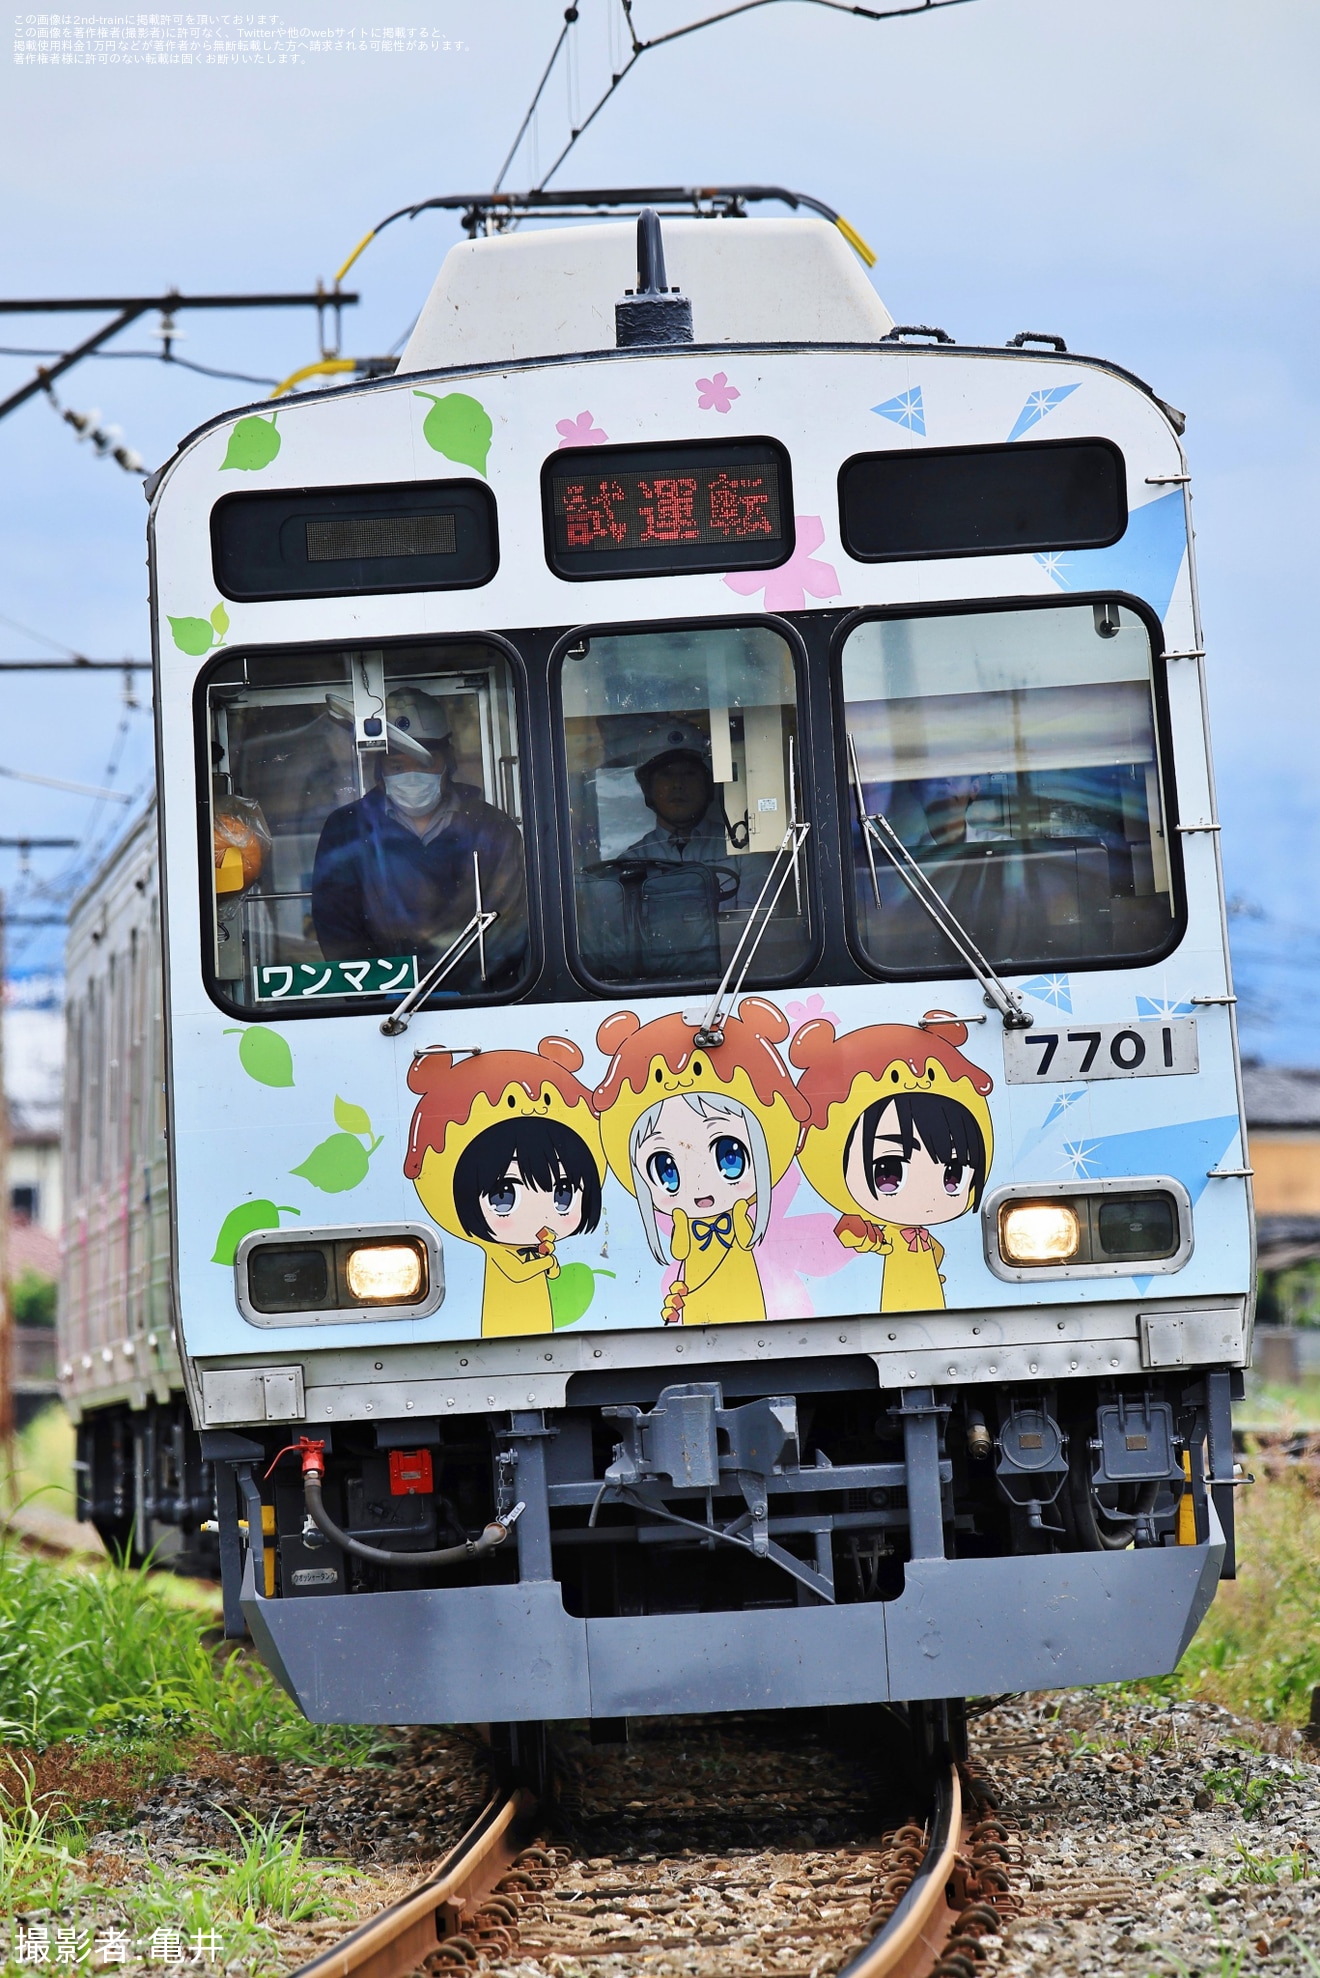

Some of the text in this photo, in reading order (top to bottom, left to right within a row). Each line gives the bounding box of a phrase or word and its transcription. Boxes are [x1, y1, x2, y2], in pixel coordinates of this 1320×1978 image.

[563, 473, 773, 546] 試運転
[262, 958, 410, 998] ワンマン
[1024, 1027, 1174, 1076] 7701
